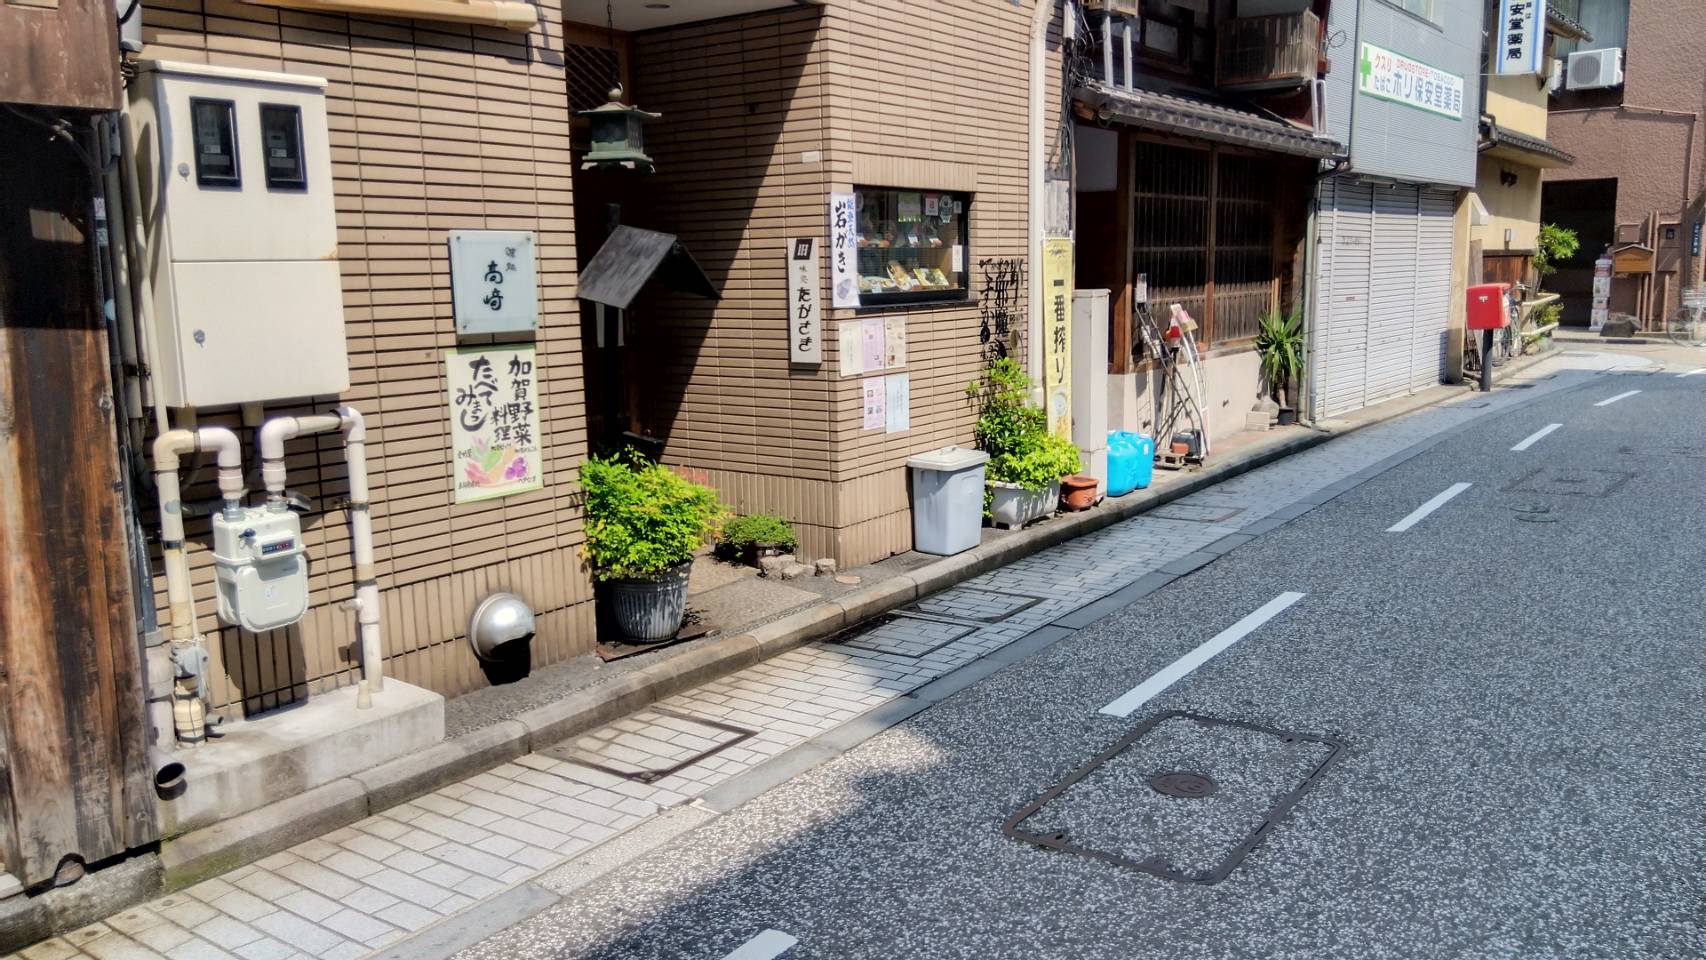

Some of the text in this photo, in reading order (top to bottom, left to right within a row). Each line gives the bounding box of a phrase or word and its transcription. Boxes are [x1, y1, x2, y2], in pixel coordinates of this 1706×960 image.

[1374, 74, 1391, 94] たばこ
[1375, 53, 1392, 73] クスリ
[834, 200, 848, 274] 岩がき
[1053, 279, 1066, 384] 一番搾り
[468, 354, 499, 407] たべて
[508, 353, 534, 446] 加賀野菜
[491, 403, 511, 443] 料理
